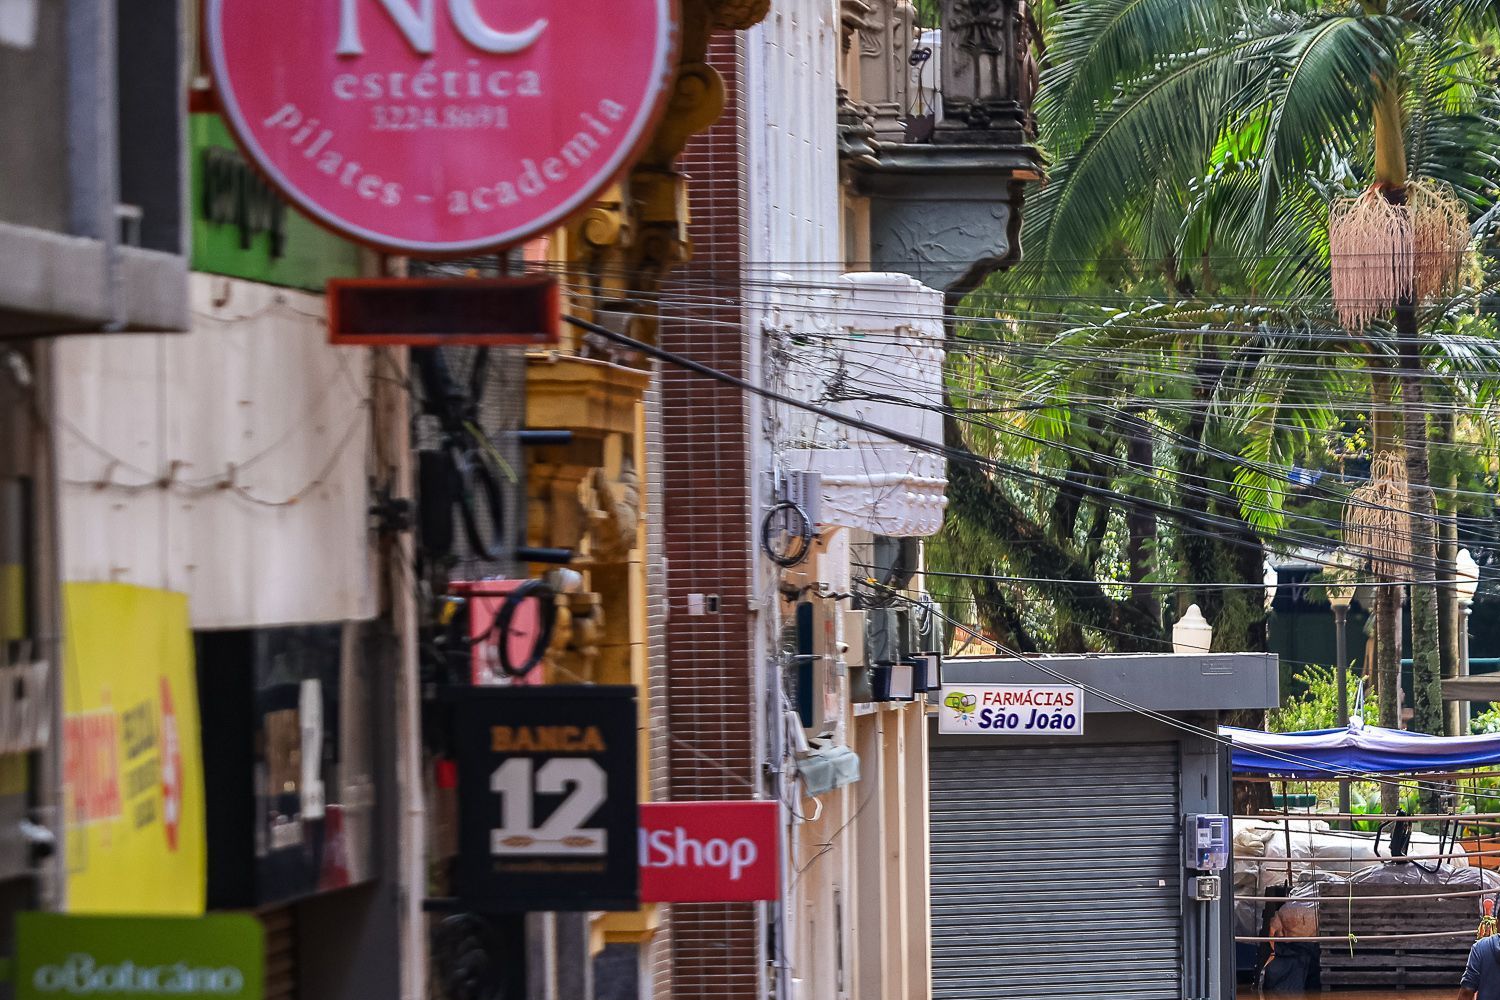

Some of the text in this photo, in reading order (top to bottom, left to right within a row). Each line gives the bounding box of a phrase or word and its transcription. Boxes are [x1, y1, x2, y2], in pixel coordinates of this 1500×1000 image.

[332, 60, 543, 100] estética
[448, 97, 626, 216] academia
[982, 689, 1075, 706] FARMÁCIAS
[977, 707, 1076, 730] São João
[490, 725, 607, 752] BANCA
[489, 757, 608, 855] 12
